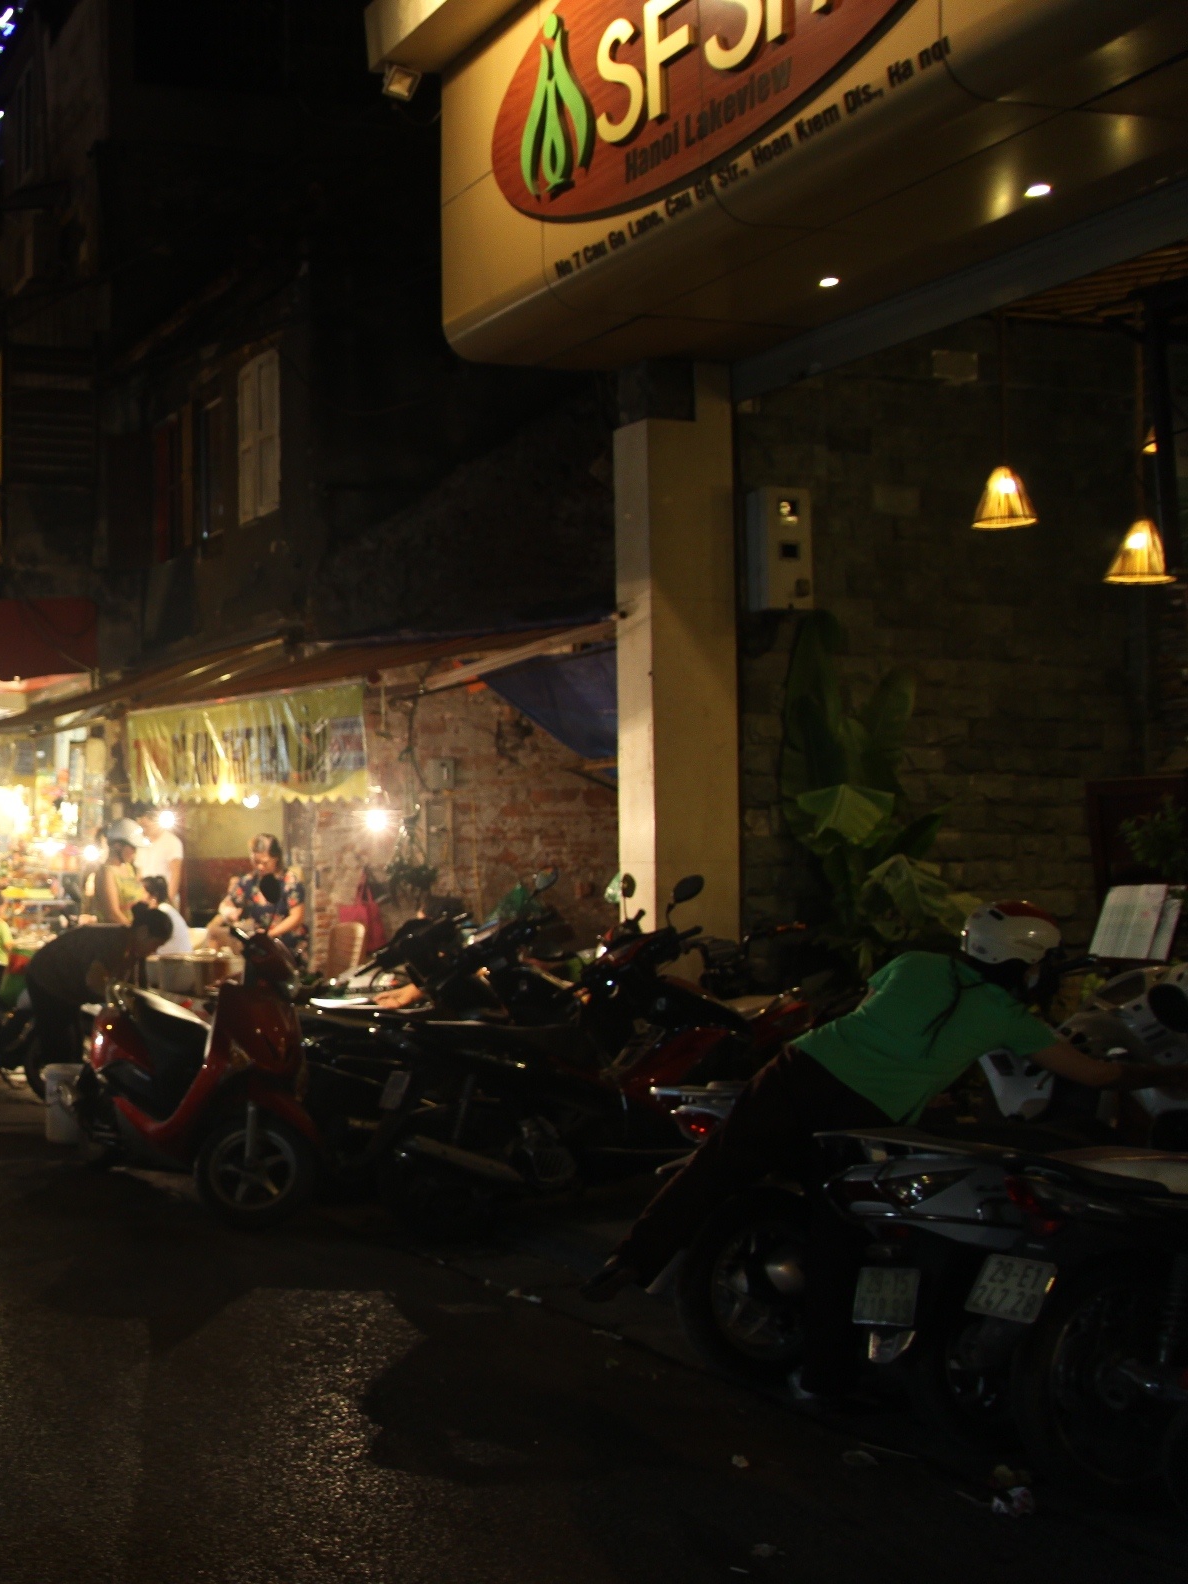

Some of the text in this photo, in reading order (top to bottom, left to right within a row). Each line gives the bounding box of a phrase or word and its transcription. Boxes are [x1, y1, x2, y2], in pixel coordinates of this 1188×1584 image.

[596, 0, 696, 145] SF
[625, 56, 793, 184] Hanoi Lakeview
[573, 252, 581, 271] 7
[583, 241, 608, 264] Cau
[608, 230, 626, 250] Go
[665, 190, 692, 218] Cau
[751, 131, 793, 167] Hoan
[887, 58, 914, 89] Ha
